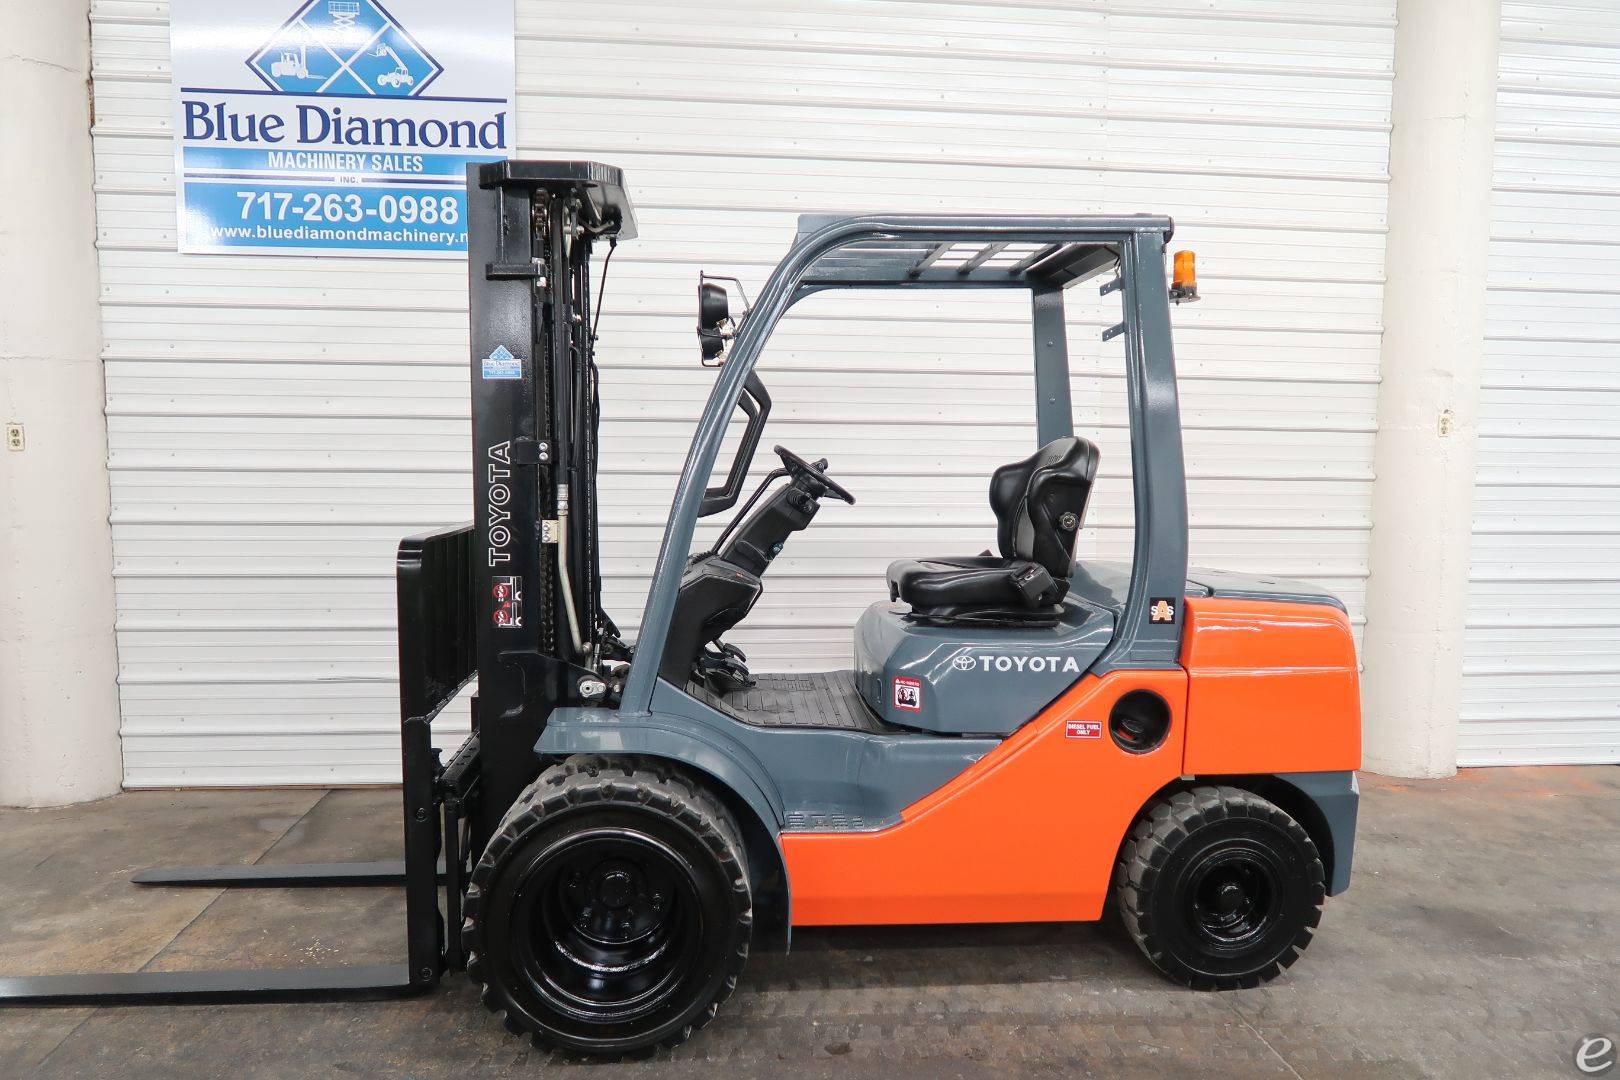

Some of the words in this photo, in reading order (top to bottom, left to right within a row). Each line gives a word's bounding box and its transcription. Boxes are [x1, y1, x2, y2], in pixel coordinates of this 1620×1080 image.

[181, 100, 285, 143] Blue
[295, 104, 507, 149] Diamond
[268, 151, 366, 171] MACHINERY
[371, 153, 423, 172] SALES
[340, 176, 359, 184] INC.
[236, 191, 459, 225] 717-263-0988
[488, 440, 511, 567] TOYOTA
[978, 655, 1080, 673] TOYOTA
